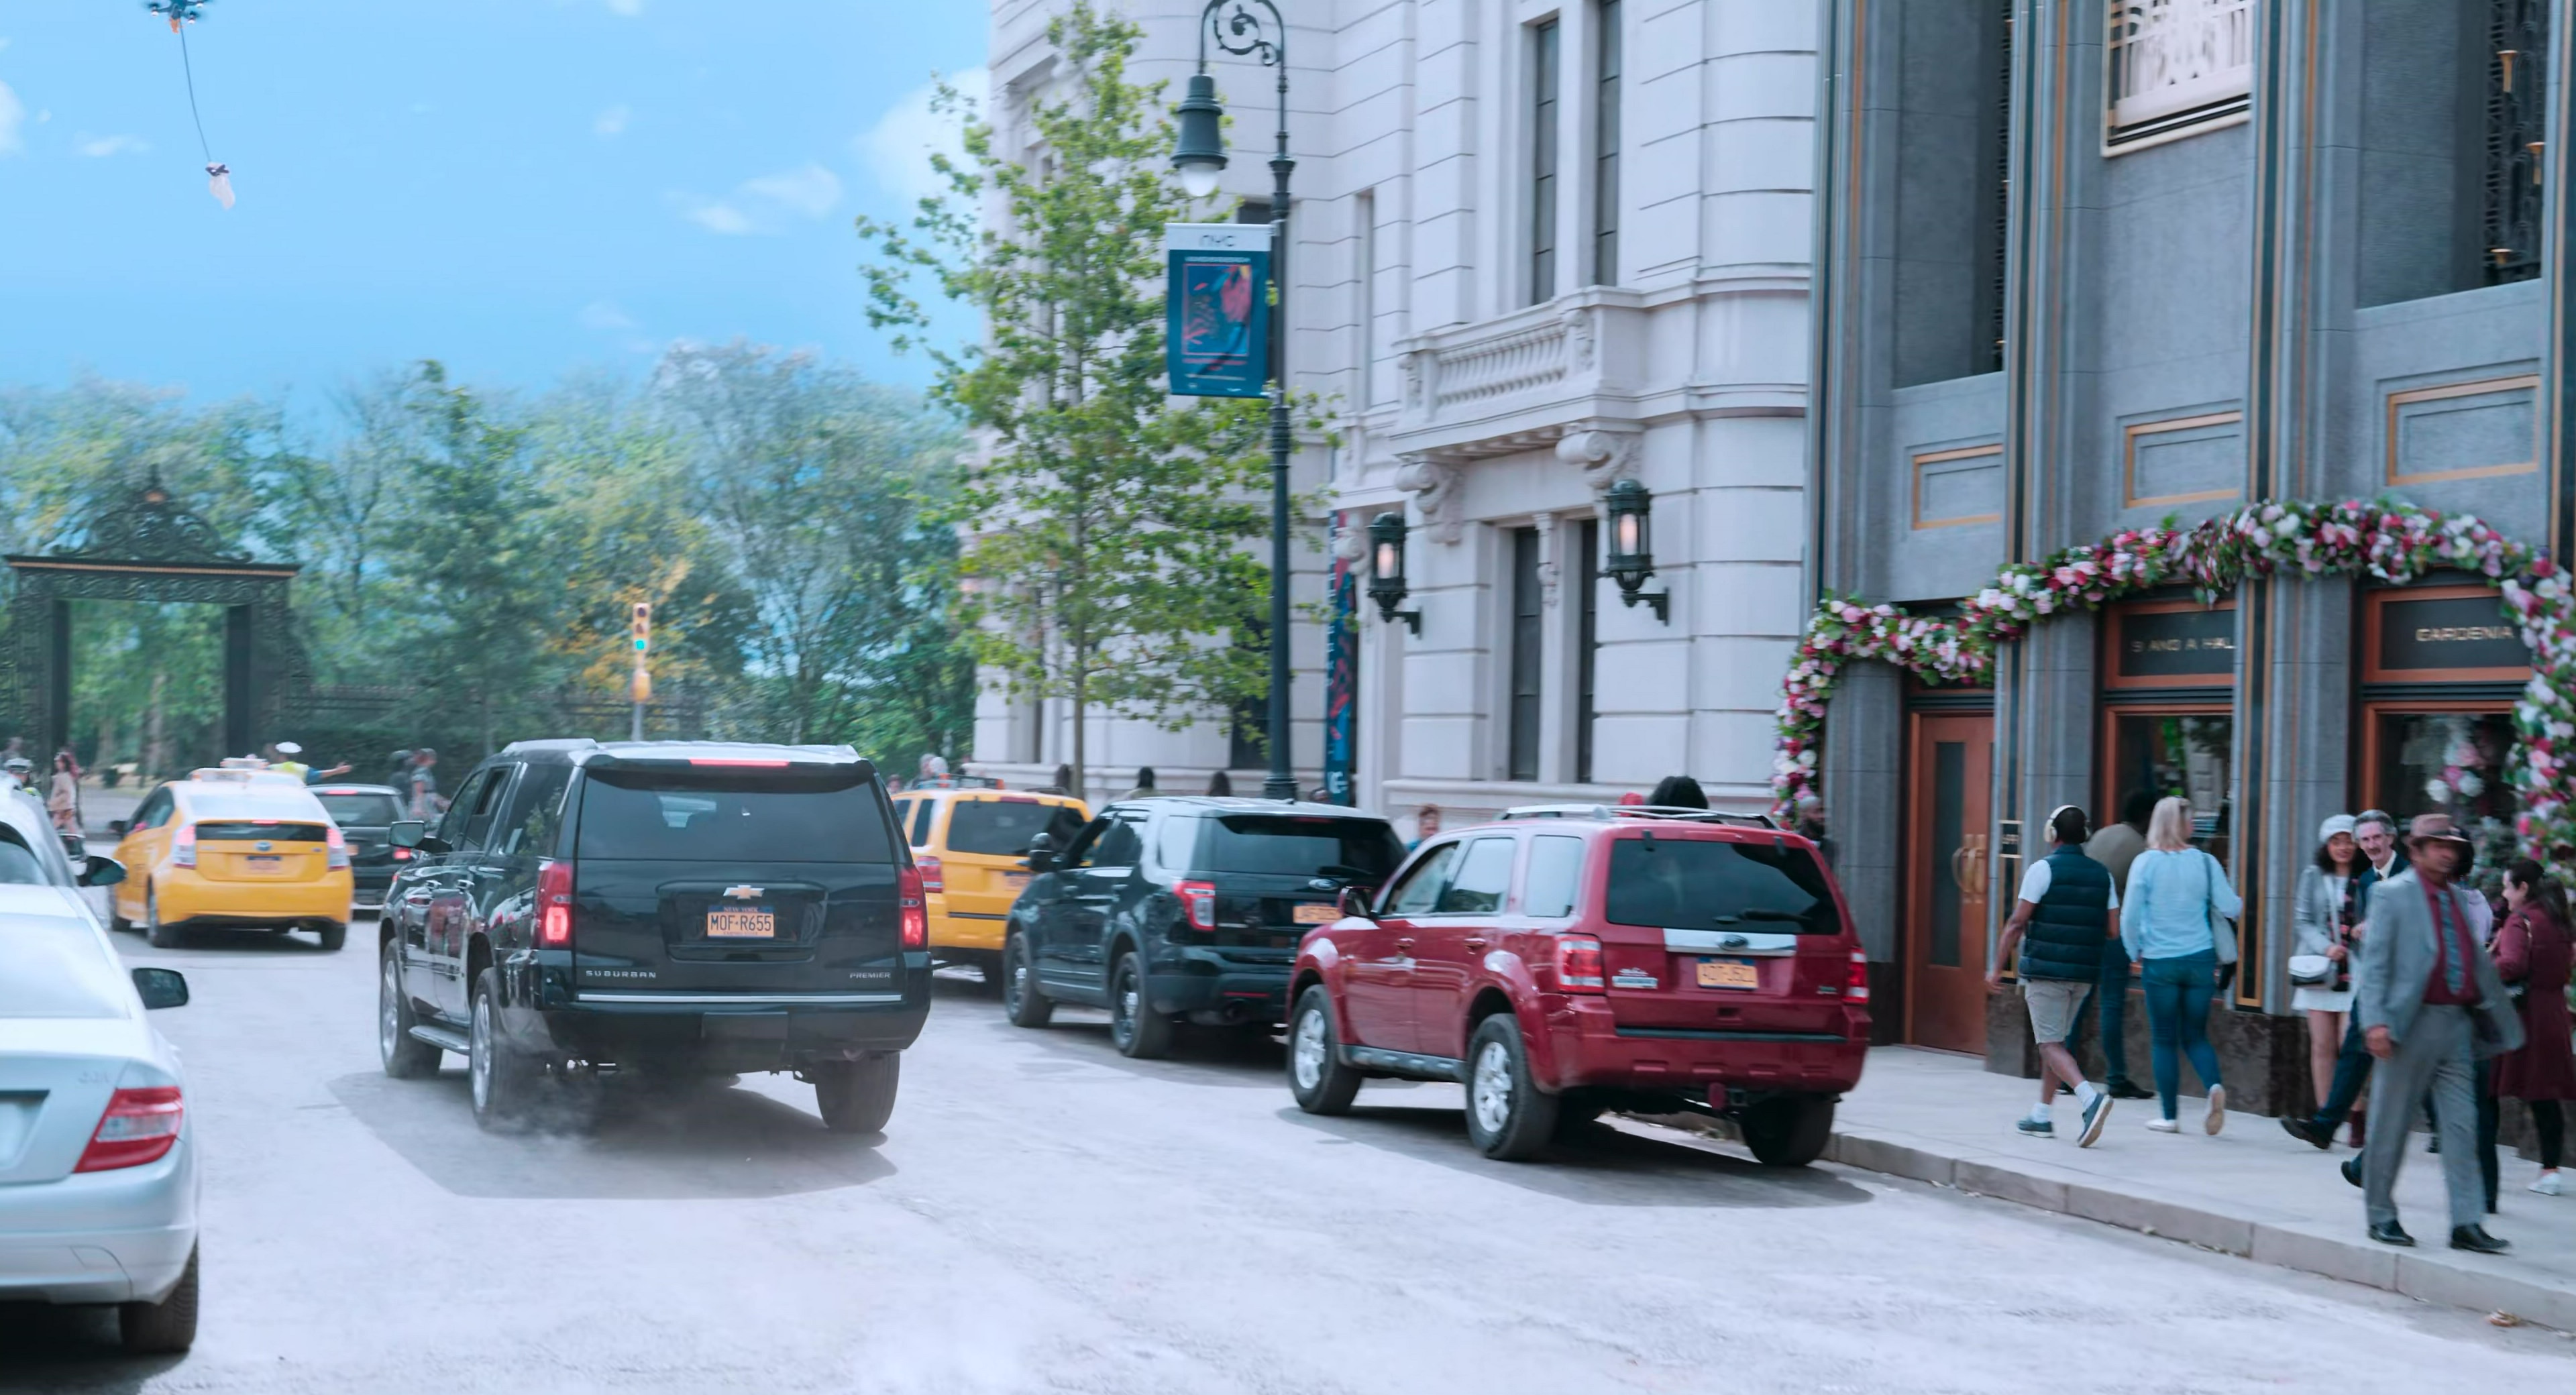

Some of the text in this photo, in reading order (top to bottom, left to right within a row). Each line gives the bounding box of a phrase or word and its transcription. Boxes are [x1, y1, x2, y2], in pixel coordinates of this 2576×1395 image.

[2416, 626, 2514, 642] GARDENIA
[2149, 638, 2181, 651] AND
[2184, 638, 2198, 650] A
[586, 970, 657, 979] SUBURBAN
